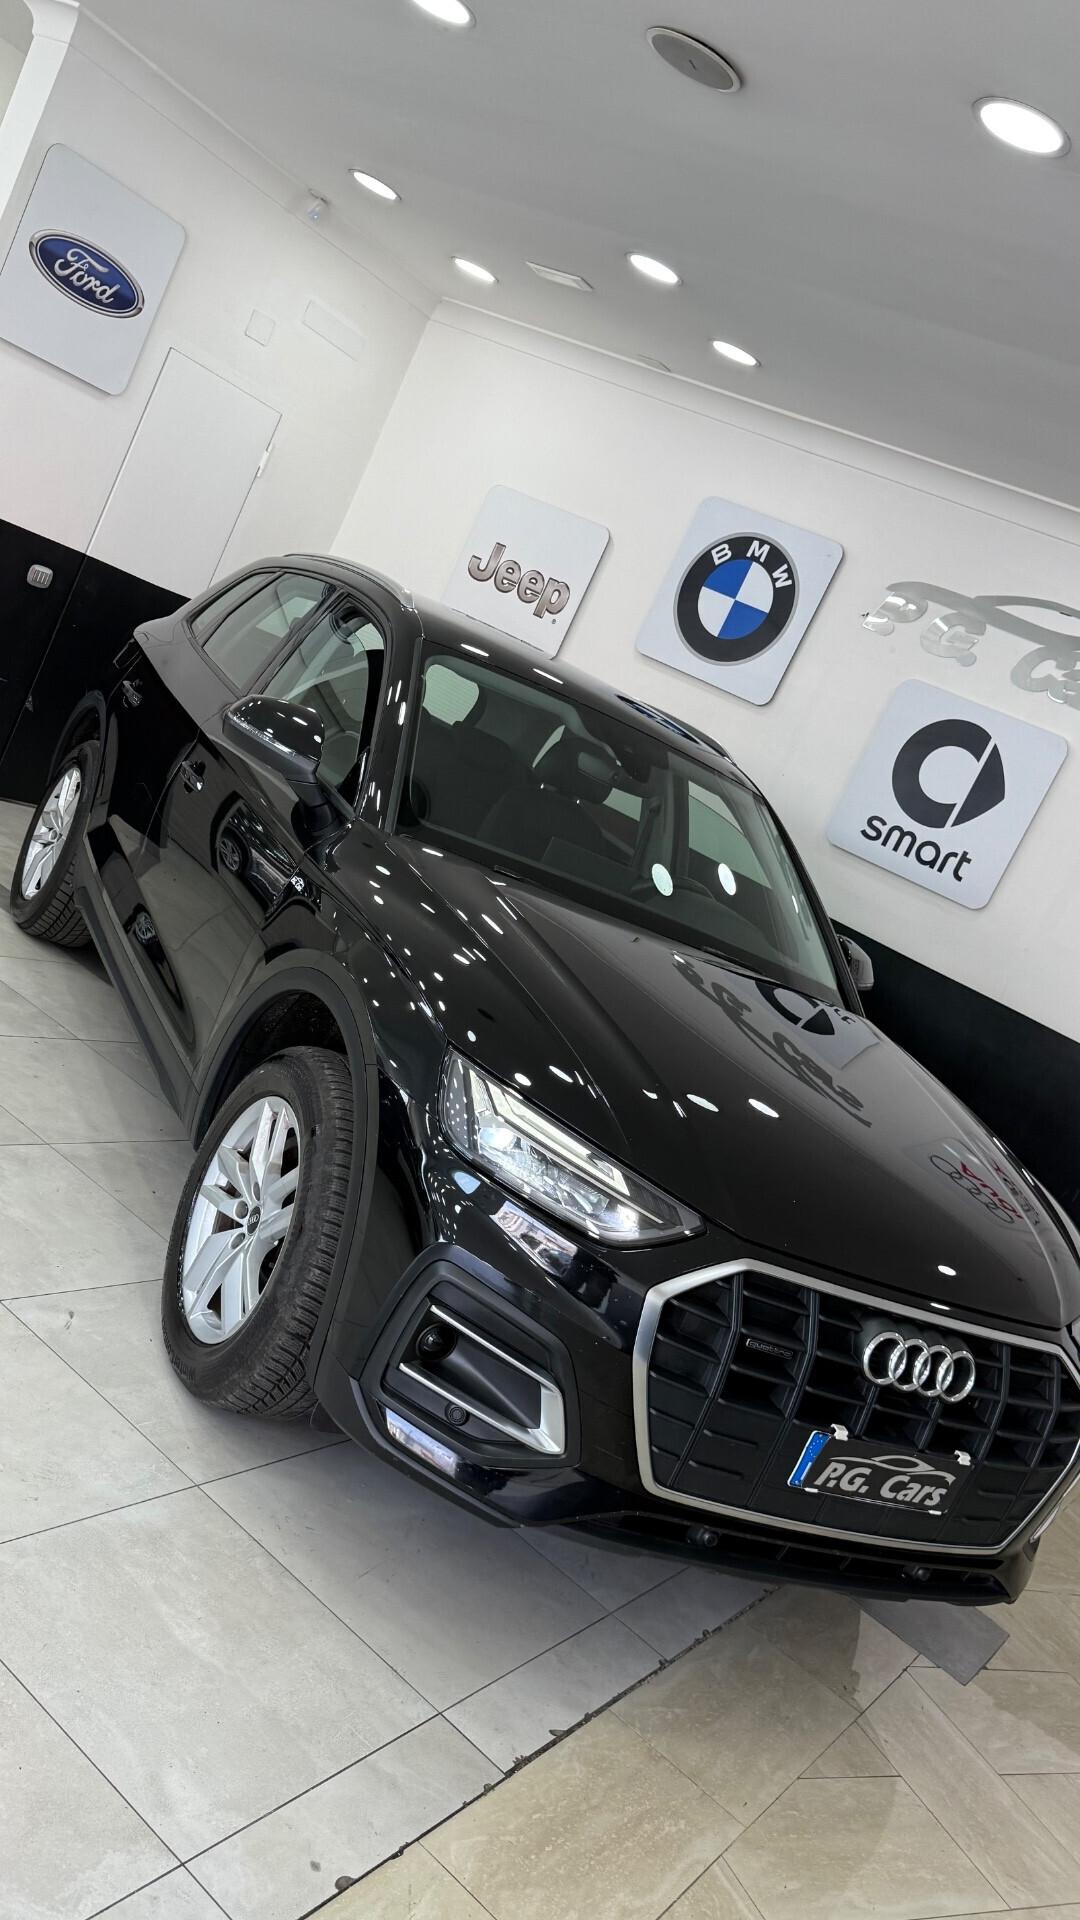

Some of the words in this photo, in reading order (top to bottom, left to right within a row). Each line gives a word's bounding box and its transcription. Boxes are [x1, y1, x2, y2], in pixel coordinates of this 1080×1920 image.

[54, 248, 120, 304] Ford
[467, 542, 571, 619] Jeep
[711, 540, 793, 589] BMW
[860, 815, 972, 882] smart
[813, 1461, 873, 1494] P.G.
[879, 1474, 948, 1506] Cars
